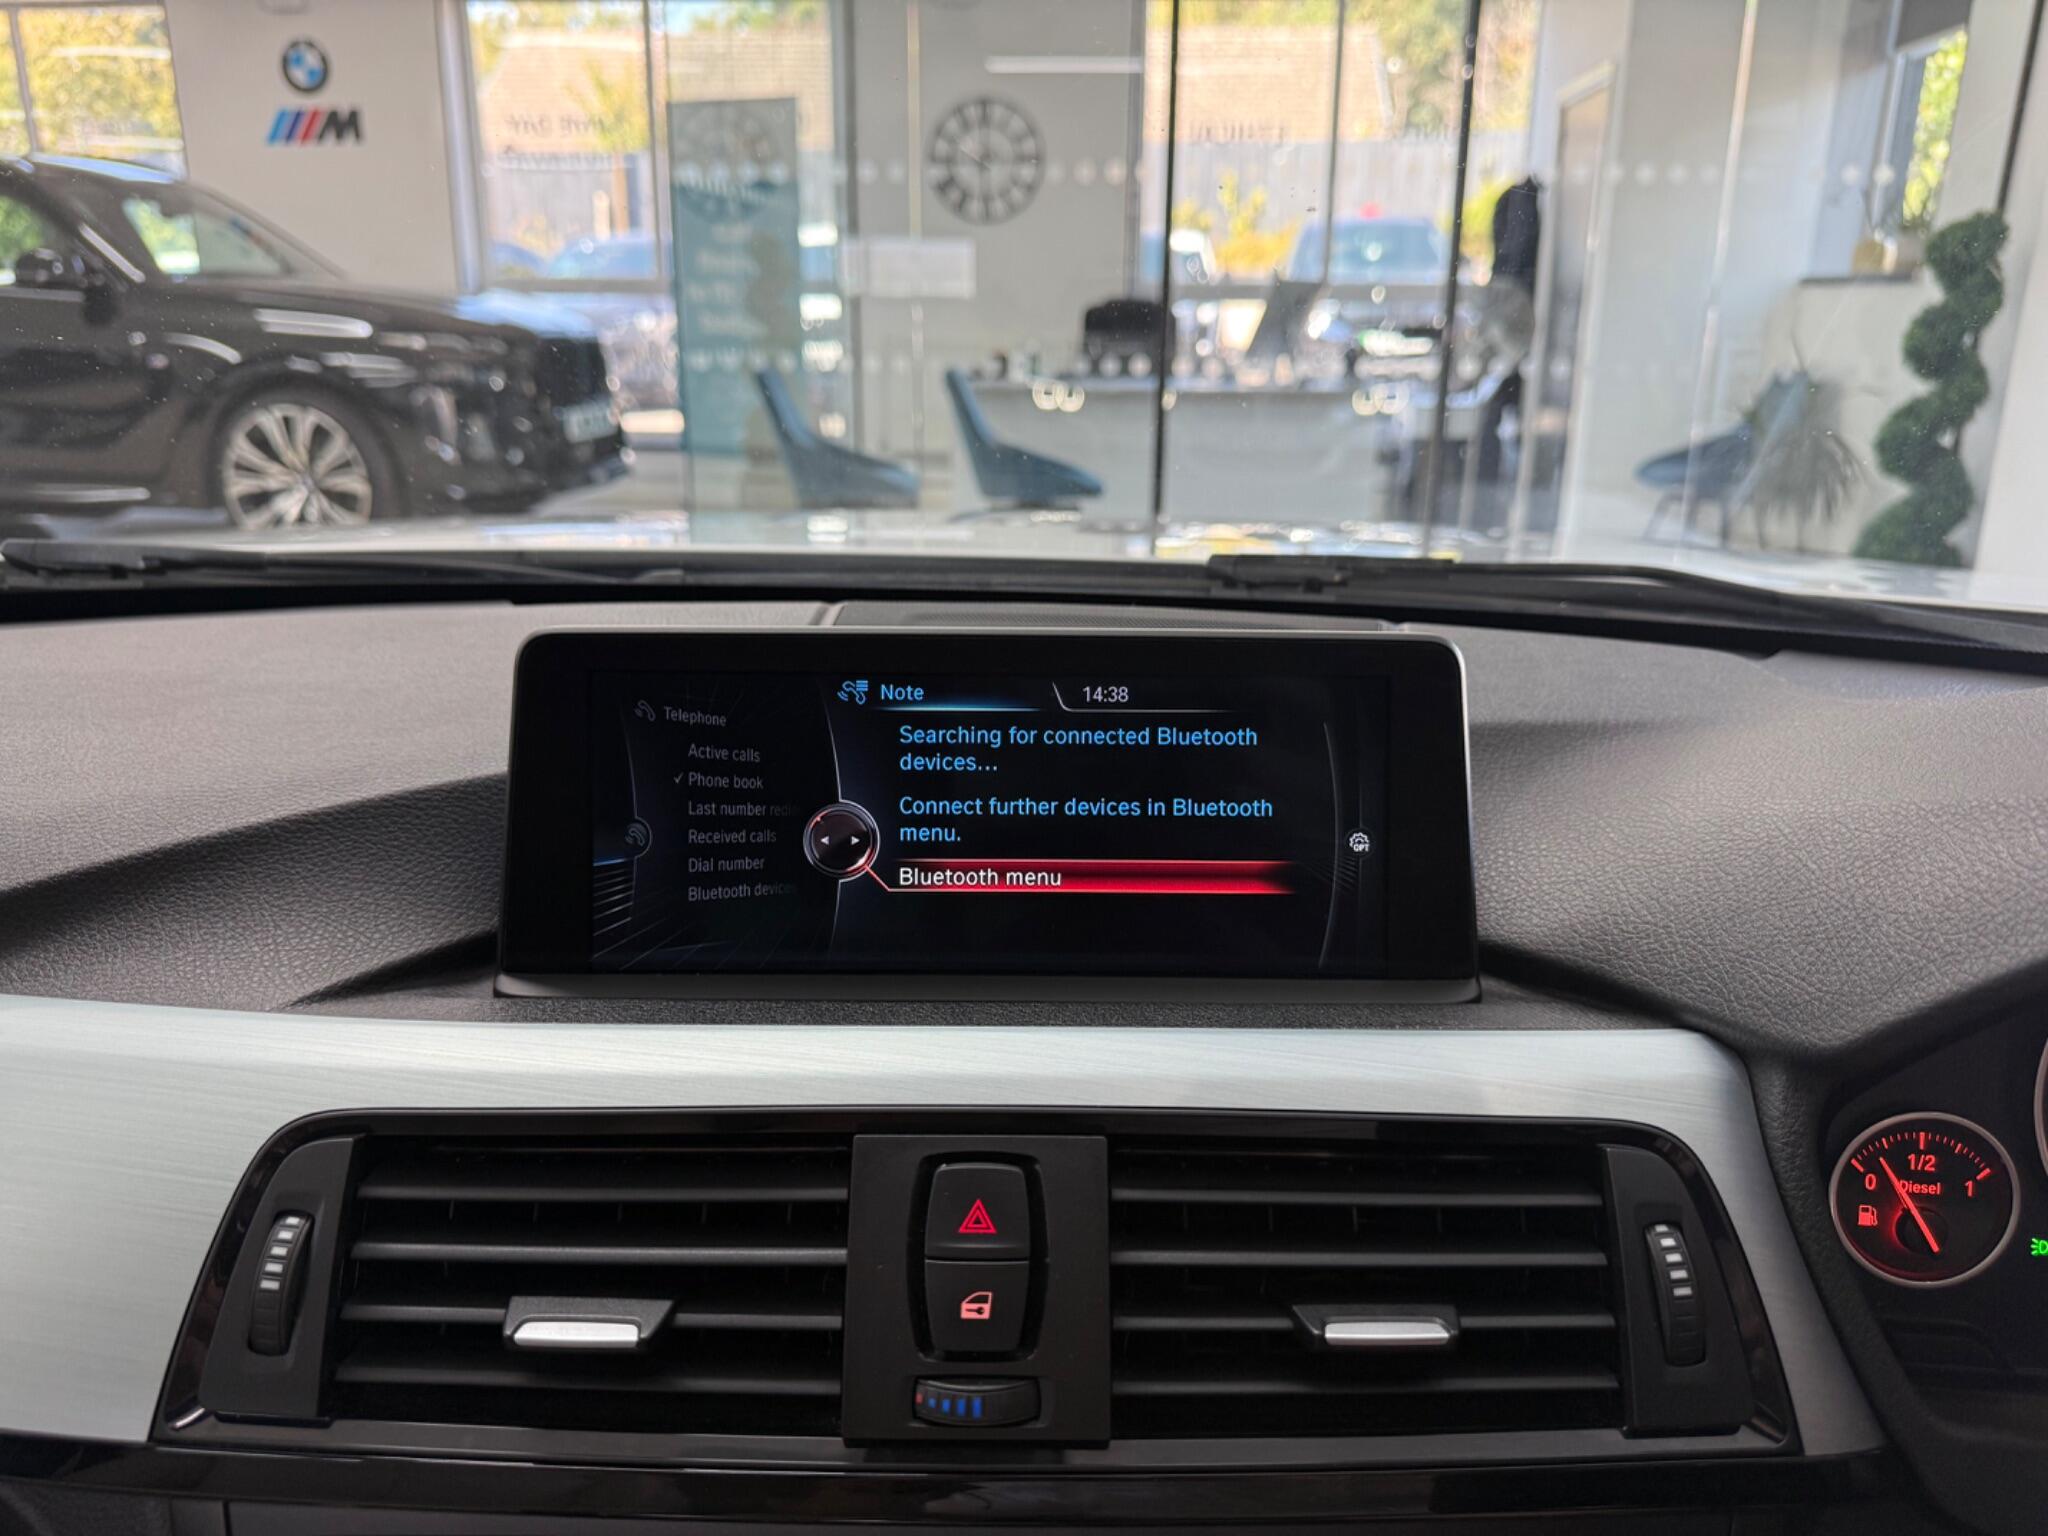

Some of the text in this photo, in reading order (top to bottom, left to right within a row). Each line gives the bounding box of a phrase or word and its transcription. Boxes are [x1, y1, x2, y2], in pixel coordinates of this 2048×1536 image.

[880, 683, 925, 702] Note
[1082, 686, 1130, 703] 14:38
[663, 706, 727, 727] Telephone
[899, 725, 1258, 749] Searching for connected Bluetooth
[687, 743, 761, 763] Active calls
[899, 752, 998, 772] devices...
[688, 772, 764, 790] Phone book
[688, 800, 716, 816] Last
[720, 801, 767, 817] number
[899, 796, 1273, 817] Connect further devices in Bluetooth
[688, 828, 777, 844] Received calls
[899, 826, 961, 842] menu.
[688, 856, 765, 873] Dial number
[899, 868, 1062, 887] Bluetooth menu
[688, 883, 751, 902] Bluetooth
[1907, 1153, 1936, 1171] 1/2
[1864, 1173, 1877, 1190] 0
[1900, 1179, 1941, 1195] Diesel
[1964, 1180, 1973, 1197] 1
